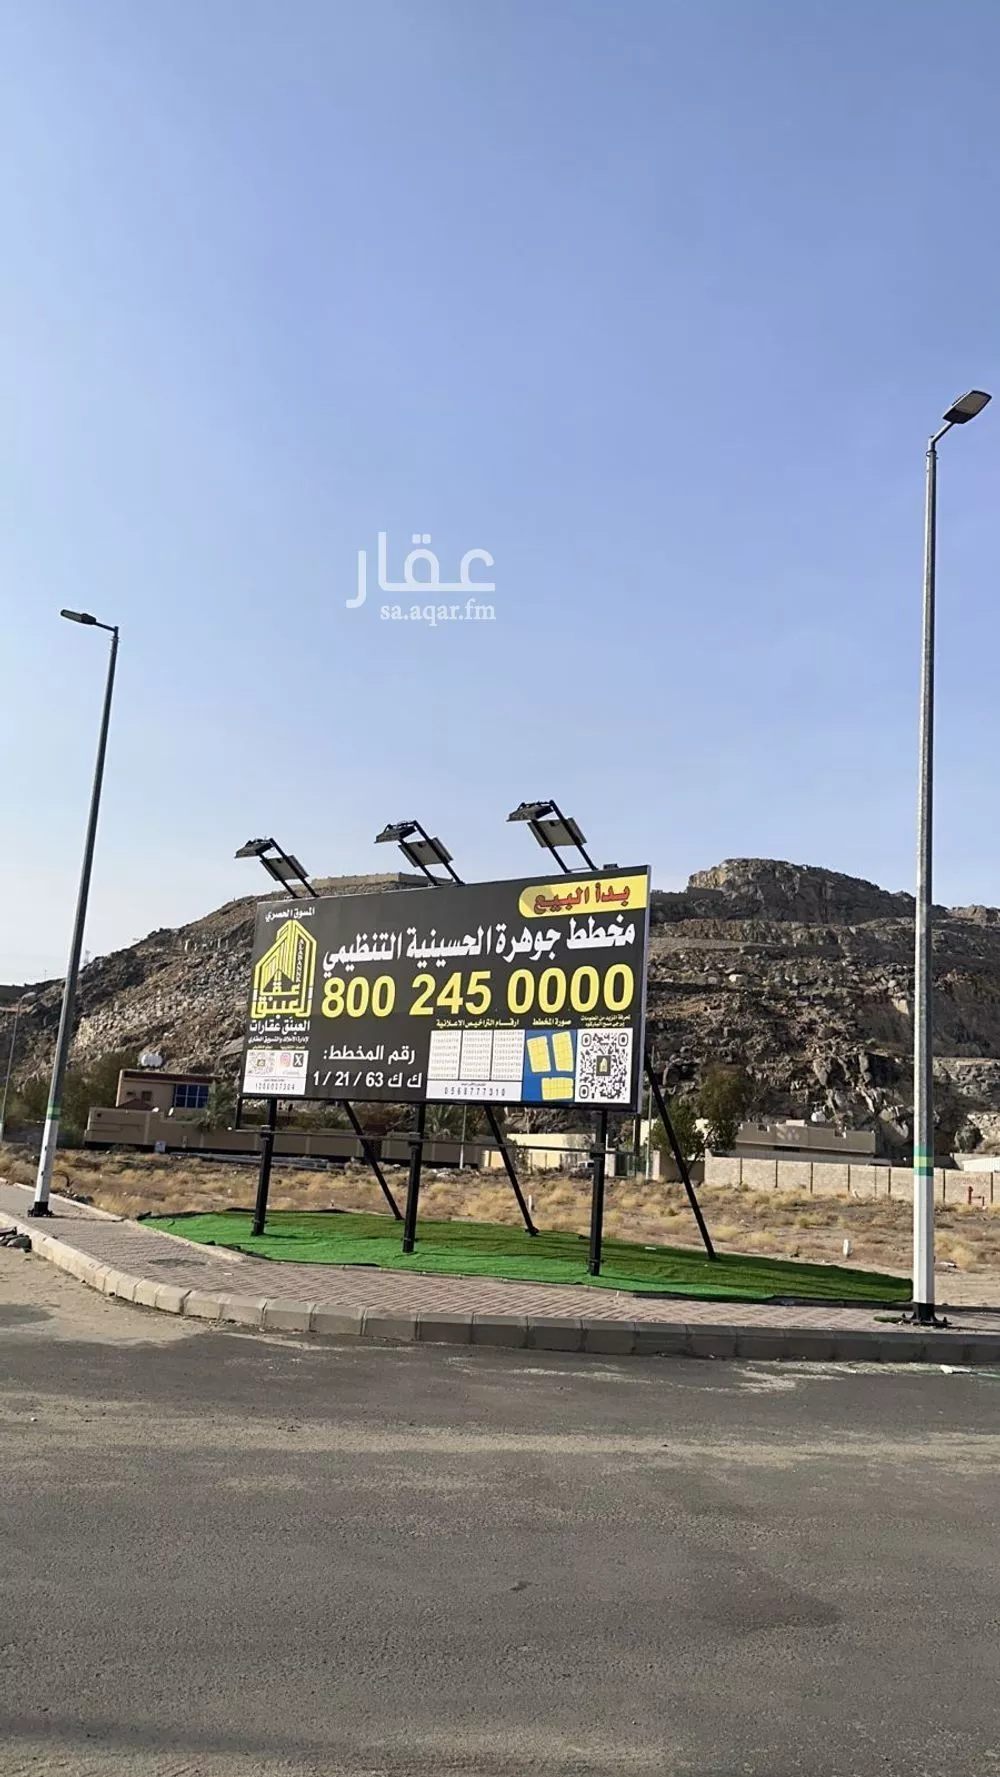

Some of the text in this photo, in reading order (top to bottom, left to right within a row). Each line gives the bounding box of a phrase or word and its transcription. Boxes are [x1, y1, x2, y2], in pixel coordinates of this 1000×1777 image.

[534, 882, 631, 914] بدأ البيع
[265, 907, 315, 922] المسوق الحصري
[566, 914, 636, 949] مخطط
[406, 925, 493, 969] الحسينية
[495, 923, 562, 963] جوهرة
[322, 931, 403, 978] التنظيمي
[321, 963, 635, 1018] 800 245 0000
[249, 1019, 281, 1035] عقارات
[464, 1018, 495, 1028] التراخيص
[532, 1018, 572, 1027] صورة المخطط
[323, 1044, 415, 1065] رقم المخطط:
[313, 1070, 320, 1086] 1
[334, 1071, 350, 1087] 21
[365, 1071, 384, 1088] 63
[387, 1072, 403, 1088] ك
[407, 1072, 422, 1088] ك
